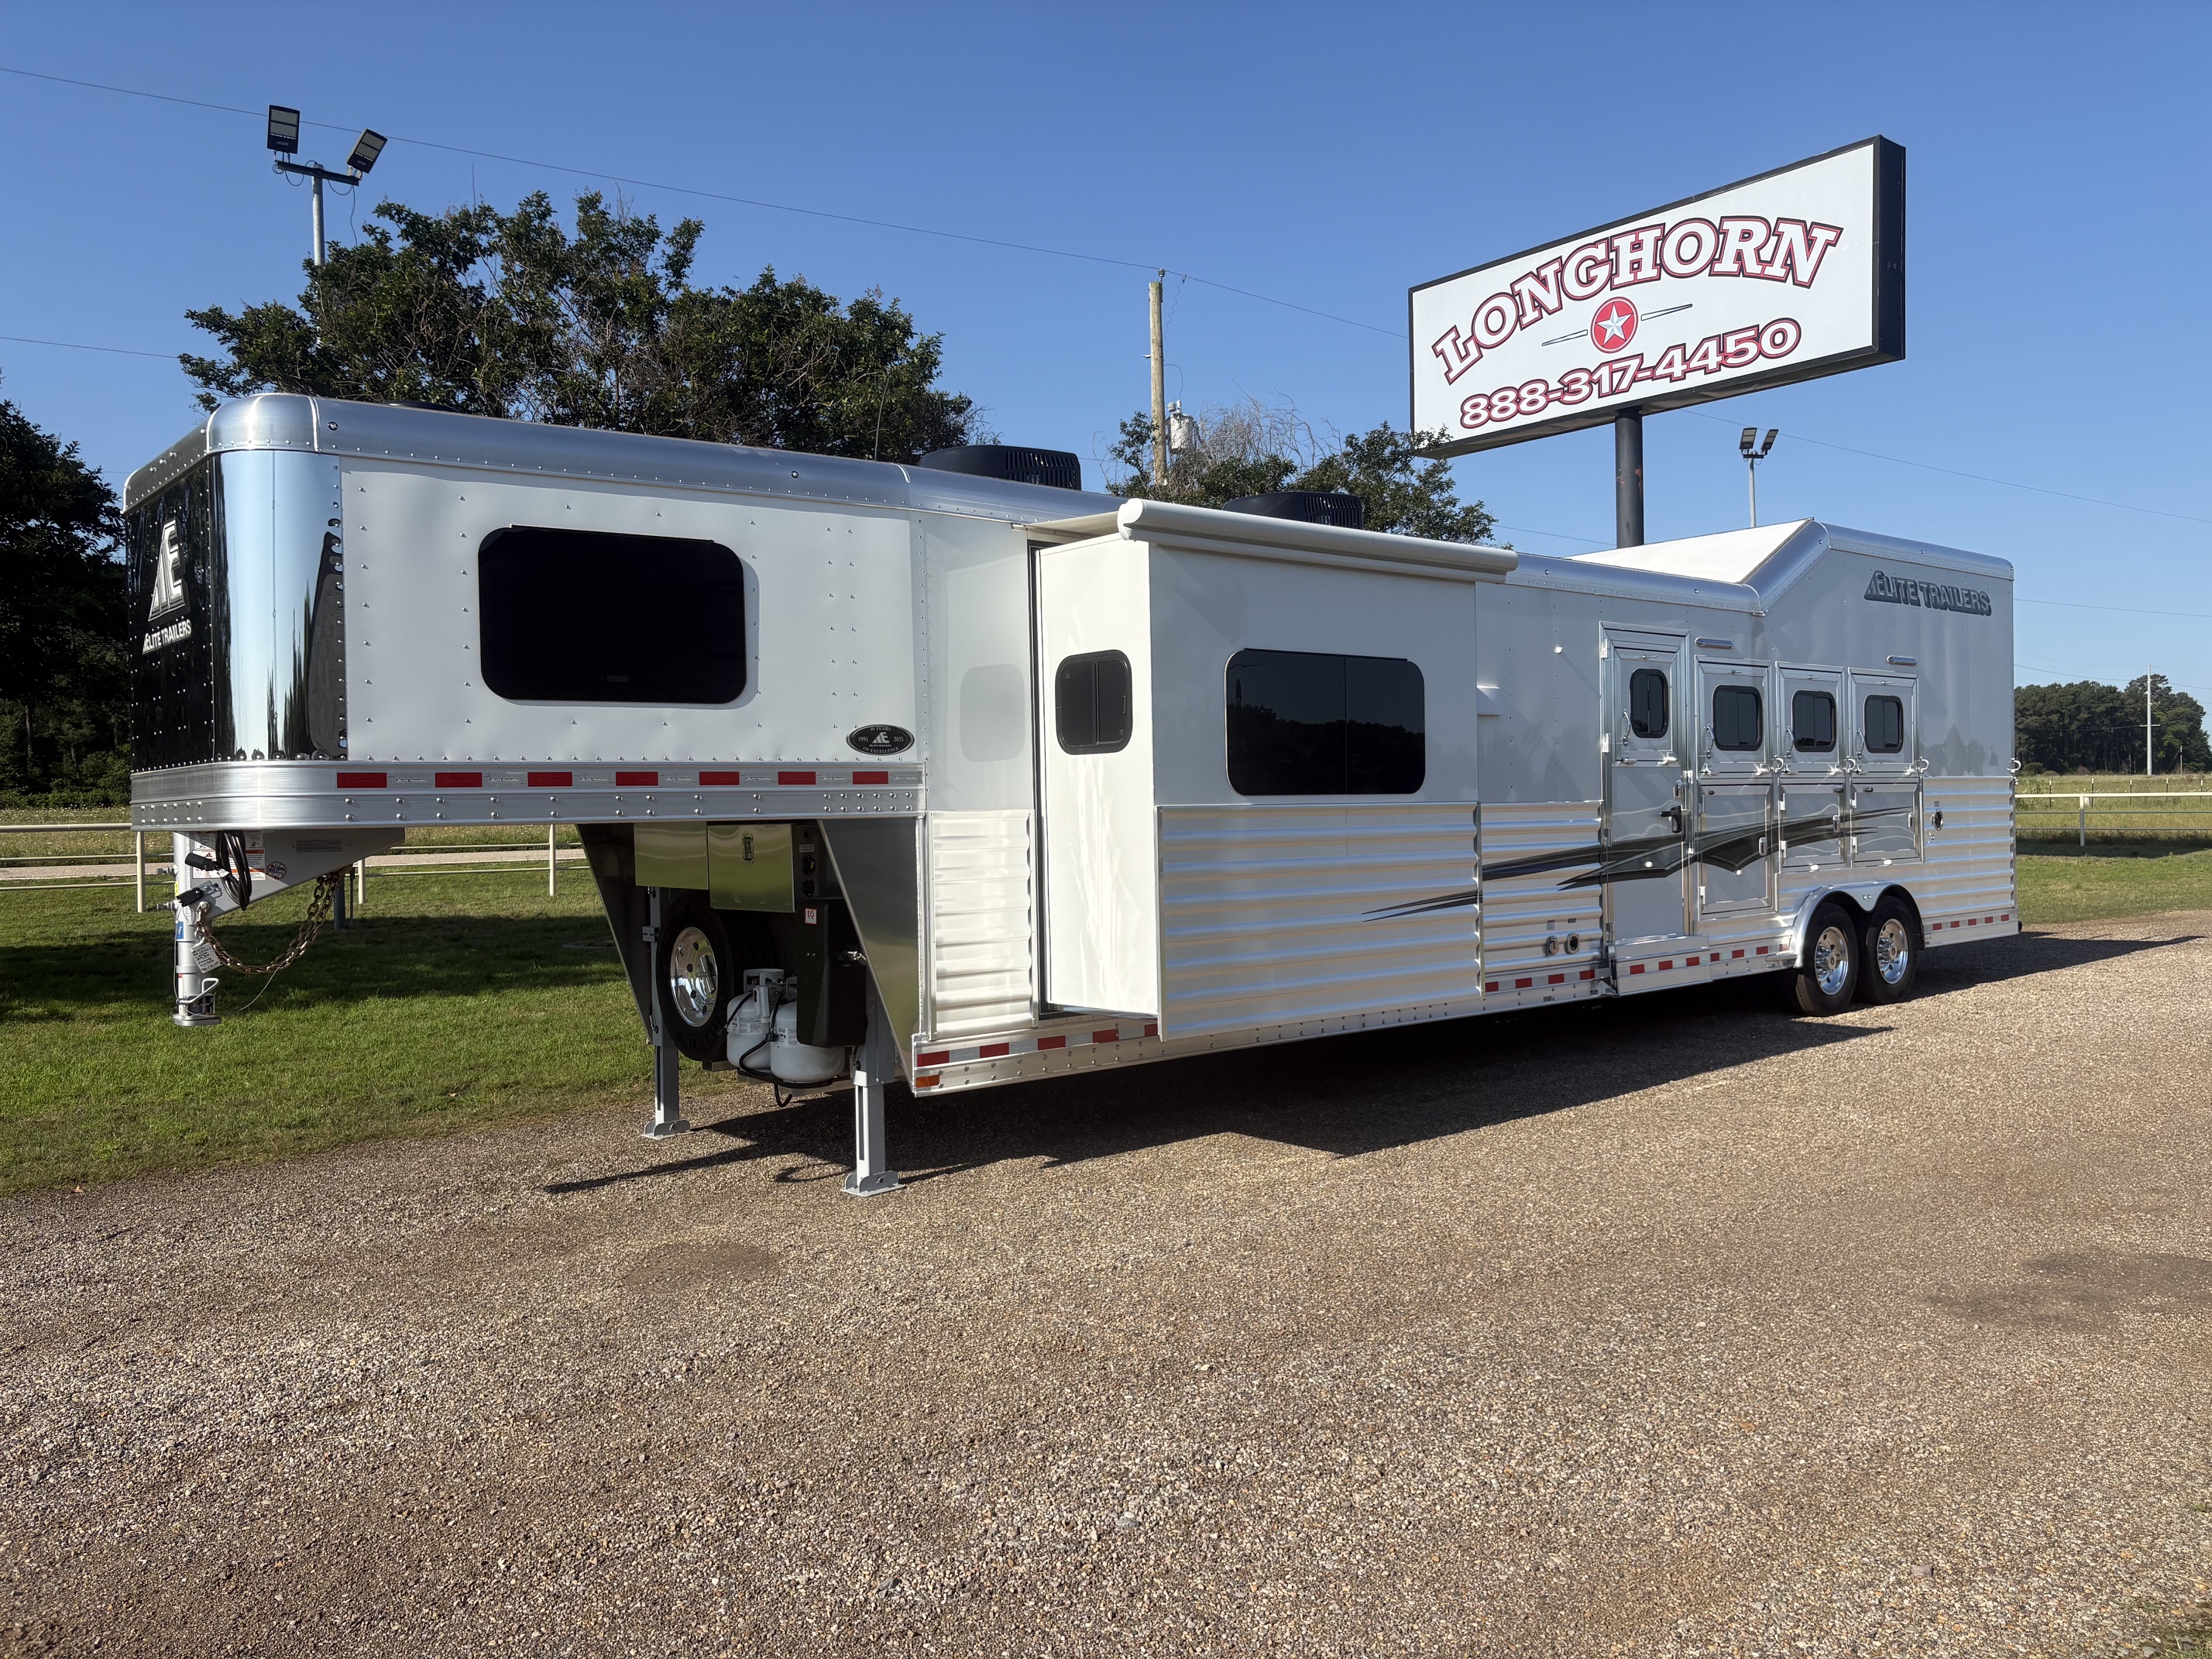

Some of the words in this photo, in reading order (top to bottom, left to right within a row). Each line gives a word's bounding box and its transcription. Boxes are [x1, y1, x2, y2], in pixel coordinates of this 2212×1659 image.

[1432, 215, 1844, 385] LONGHORN
[1460, 317, 1802, 428] 888-317-4450
[1918, 580, 1992, 617] TRAILERS
[161, 619, 192, 646] TRAILERS
[807, 910, 814, 920] EQ
